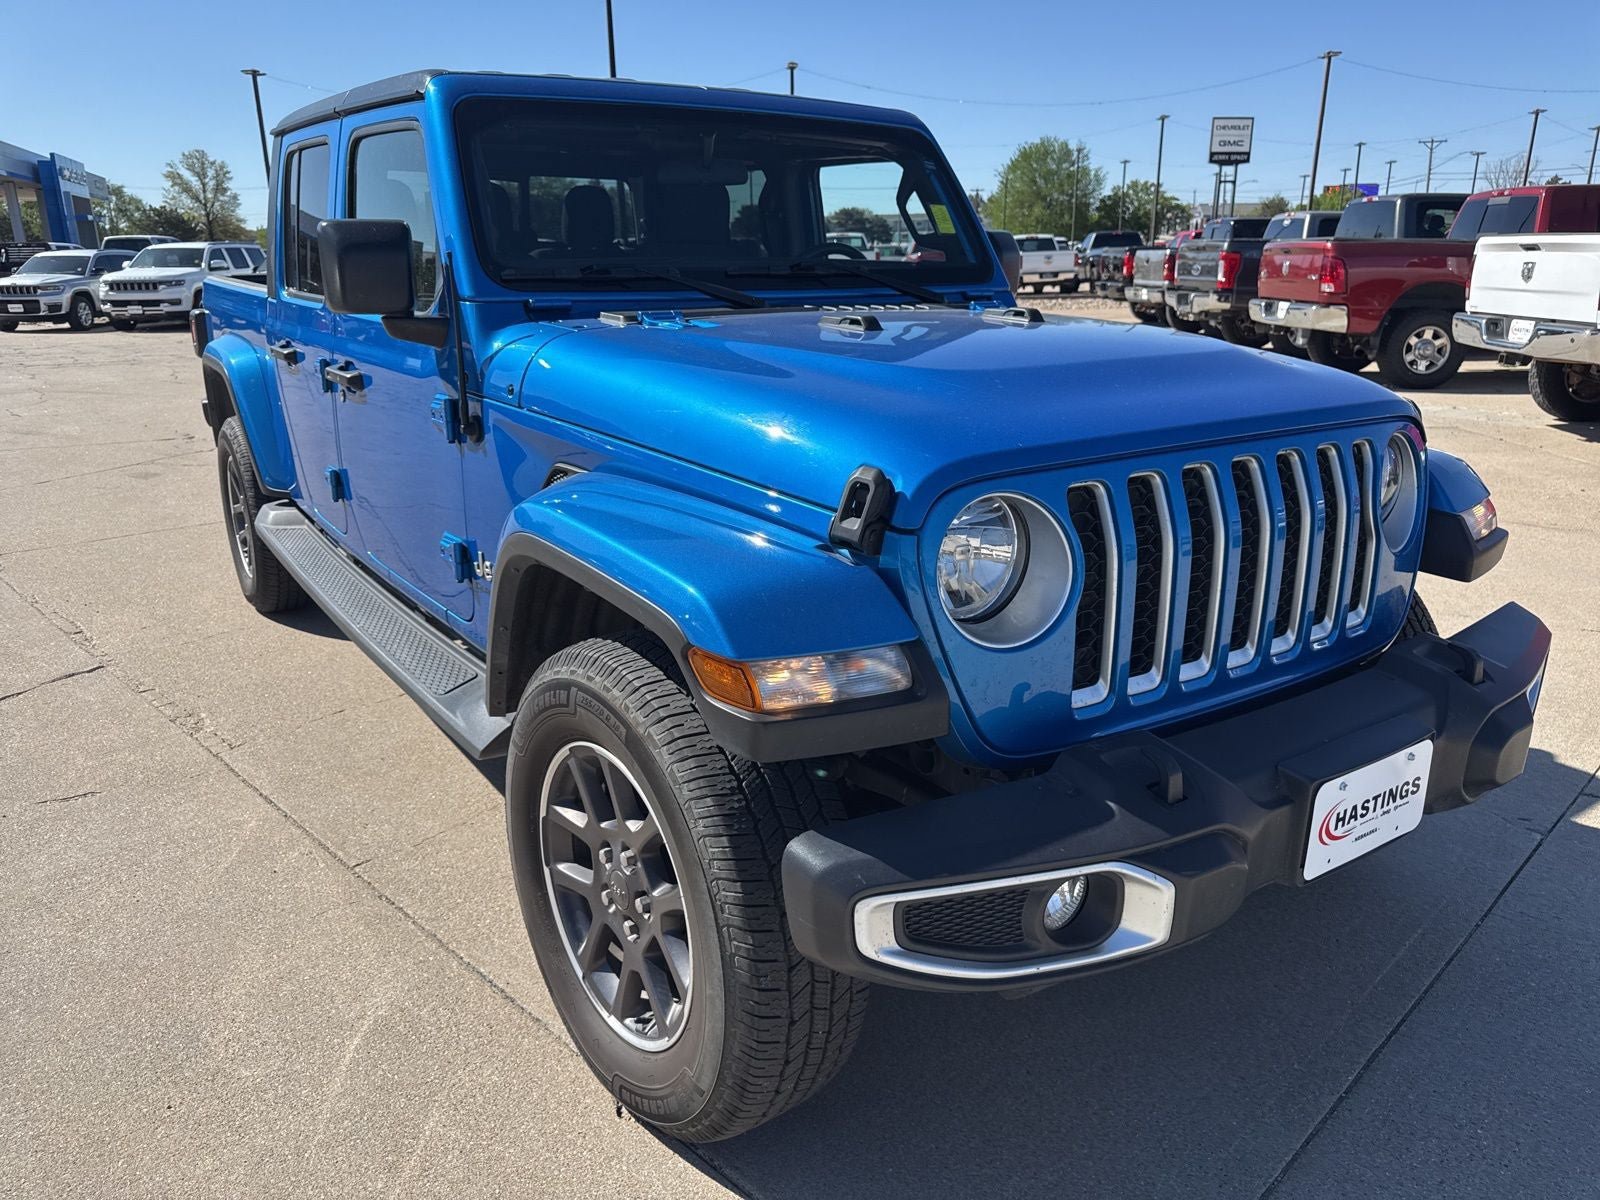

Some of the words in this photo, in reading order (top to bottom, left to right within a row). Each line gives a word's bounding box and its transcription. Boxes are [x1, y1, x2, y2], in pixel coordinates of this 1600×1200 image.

[1215, 124, 1251, 132] CHEVROLET
[1218, 139, 1245, 148] GMC
[1334, 776, 1421, 831] HASTINGS
